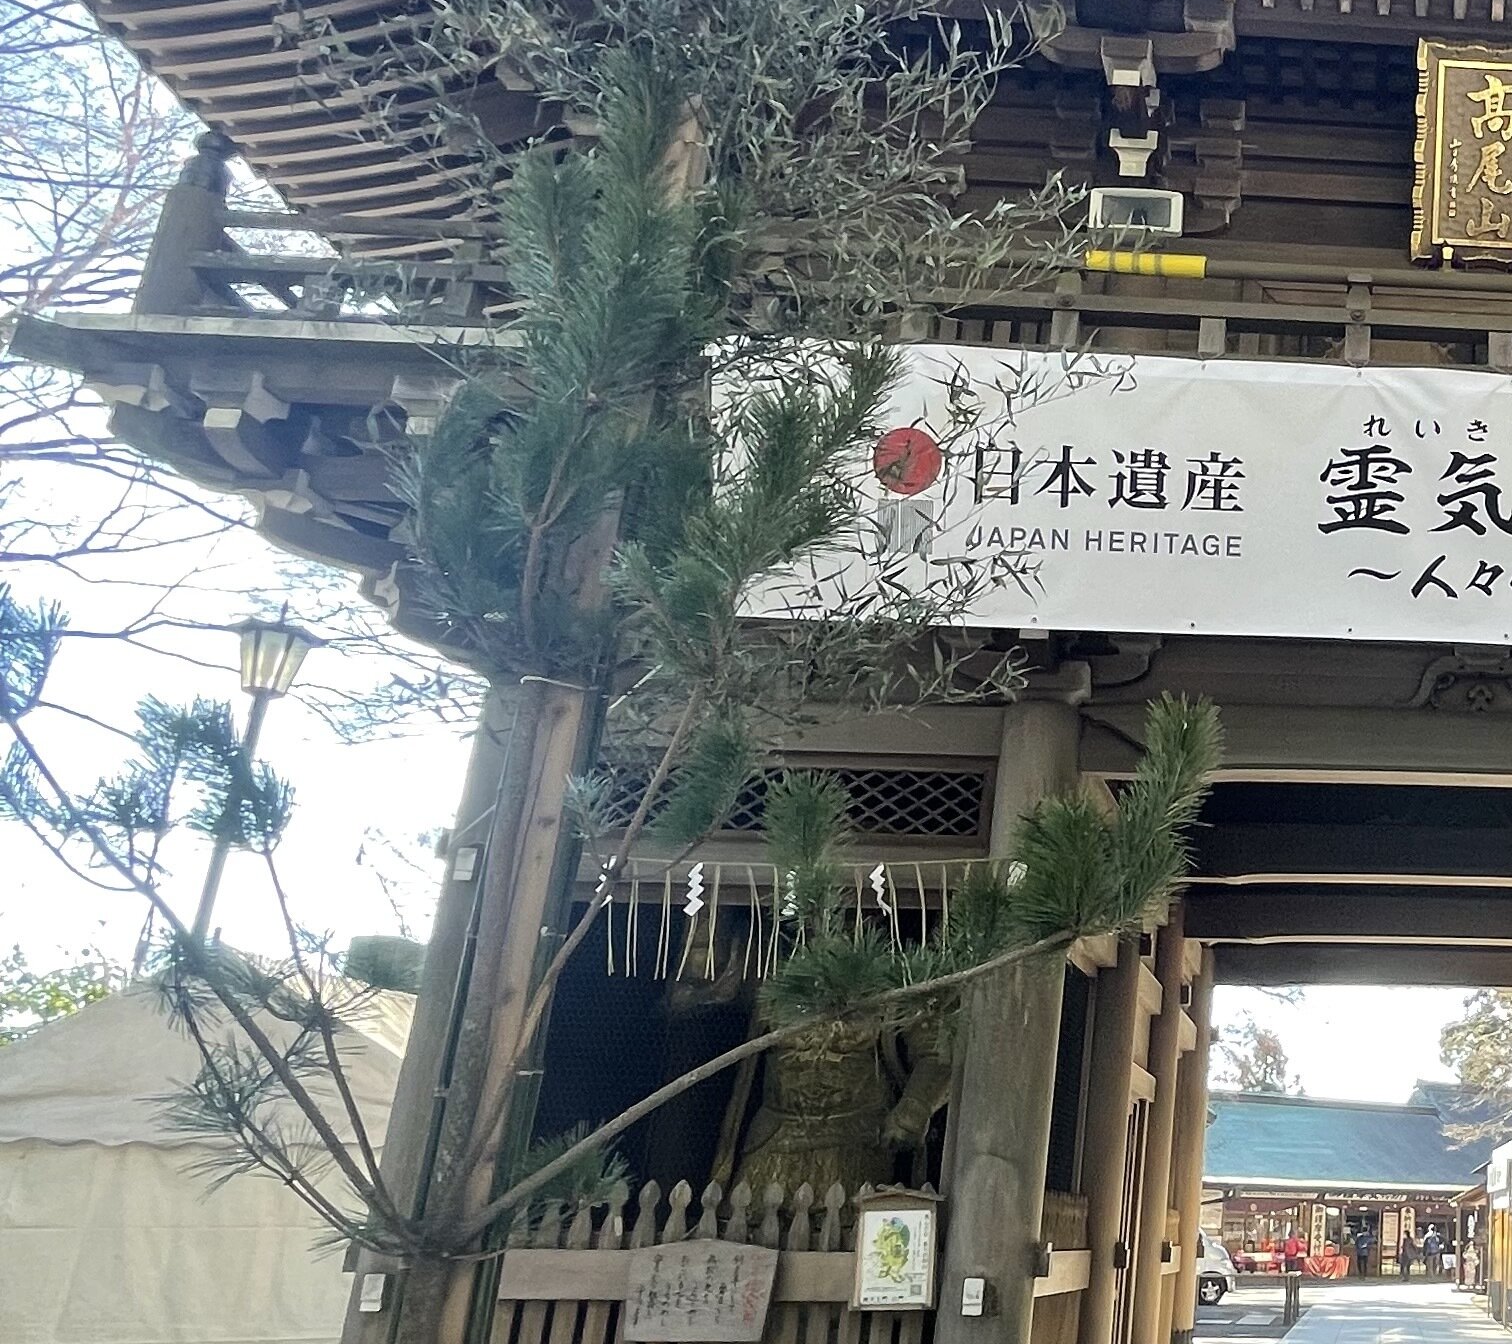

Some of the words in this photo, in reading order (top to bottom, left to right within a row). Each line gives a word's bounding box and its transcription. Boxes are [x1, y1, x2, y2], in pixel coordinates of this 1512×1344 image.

[974, 445, 1246, 512] 日本遺産
[966, 525, 1070, 552] JAPAN
[1085, 529, 1243, 557] HERITAGE
